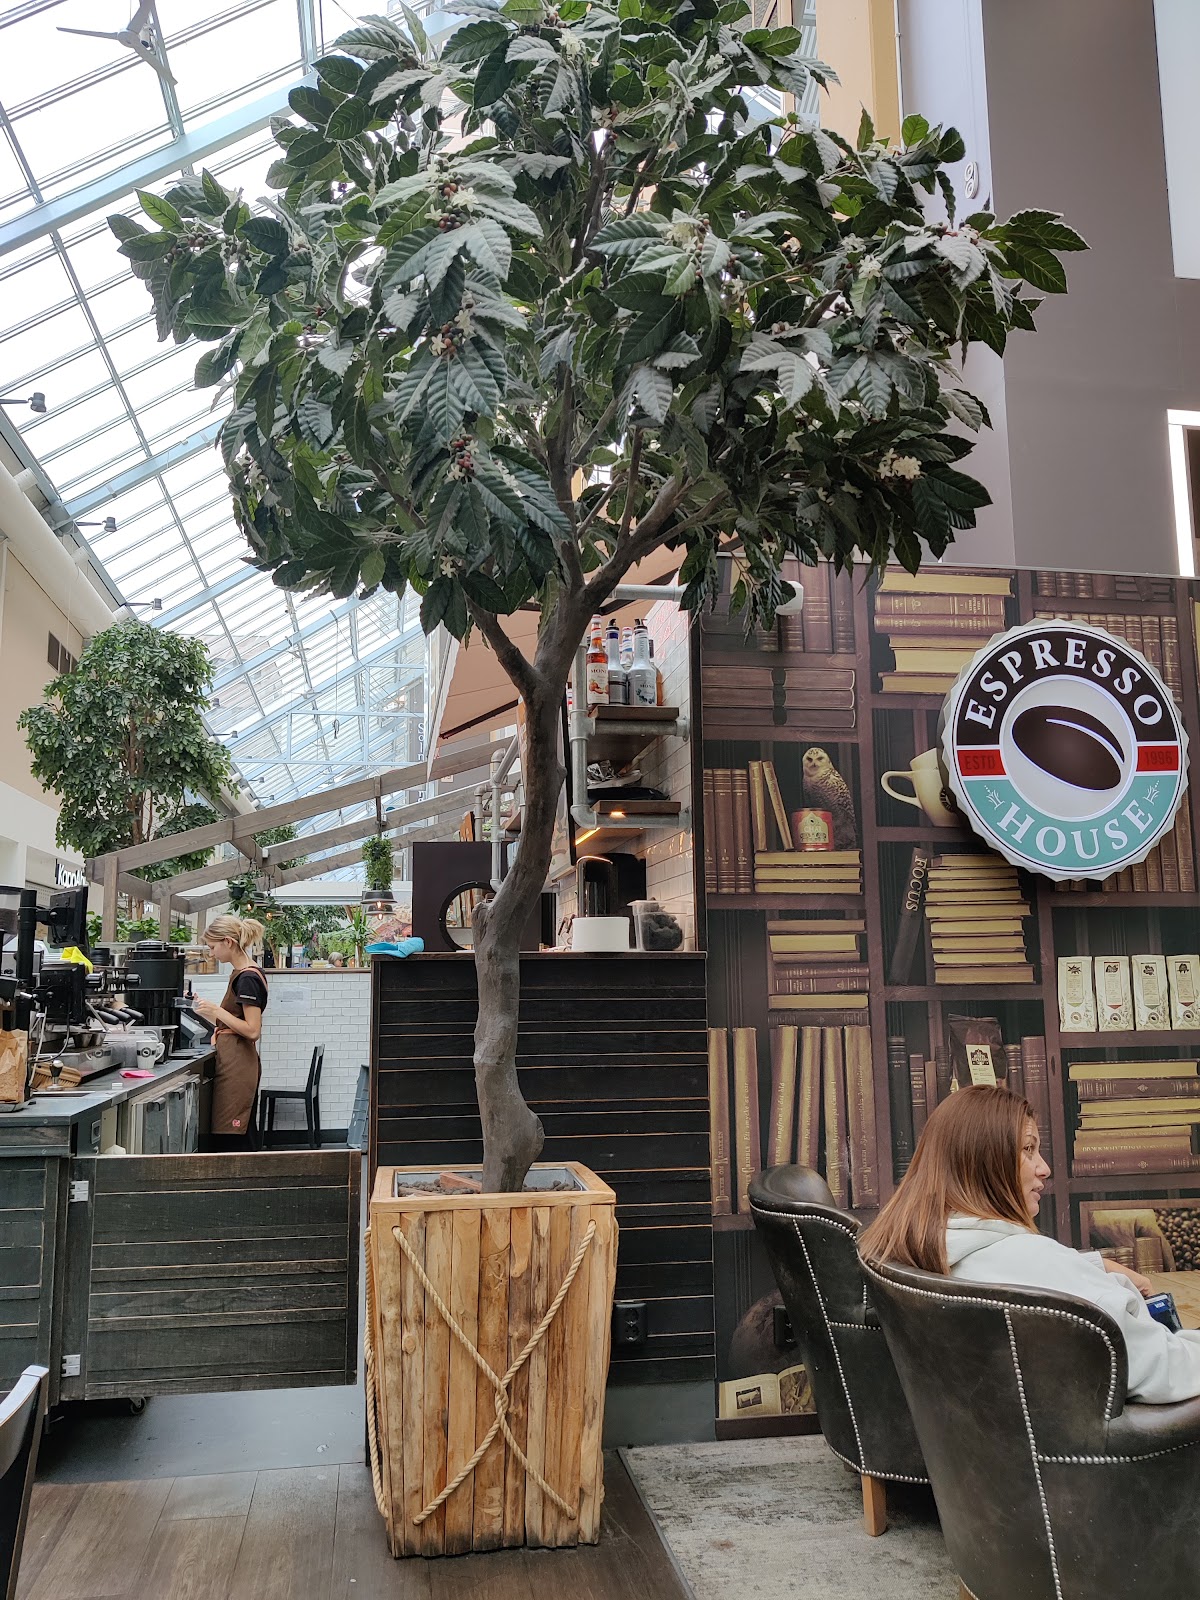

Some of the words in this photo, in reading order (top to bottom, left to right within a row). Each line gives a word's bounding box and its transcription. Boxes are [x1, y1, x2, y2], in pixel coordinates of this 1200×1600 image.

[964, 637, 1163, 730] ESPRESSO
[964, 755, 996, 771] ESTD
[997, 799, 1154, 860] HOUSE
[56, 863, 87, 888] KappAh
[905, 855, 928, 911] FOCUS
